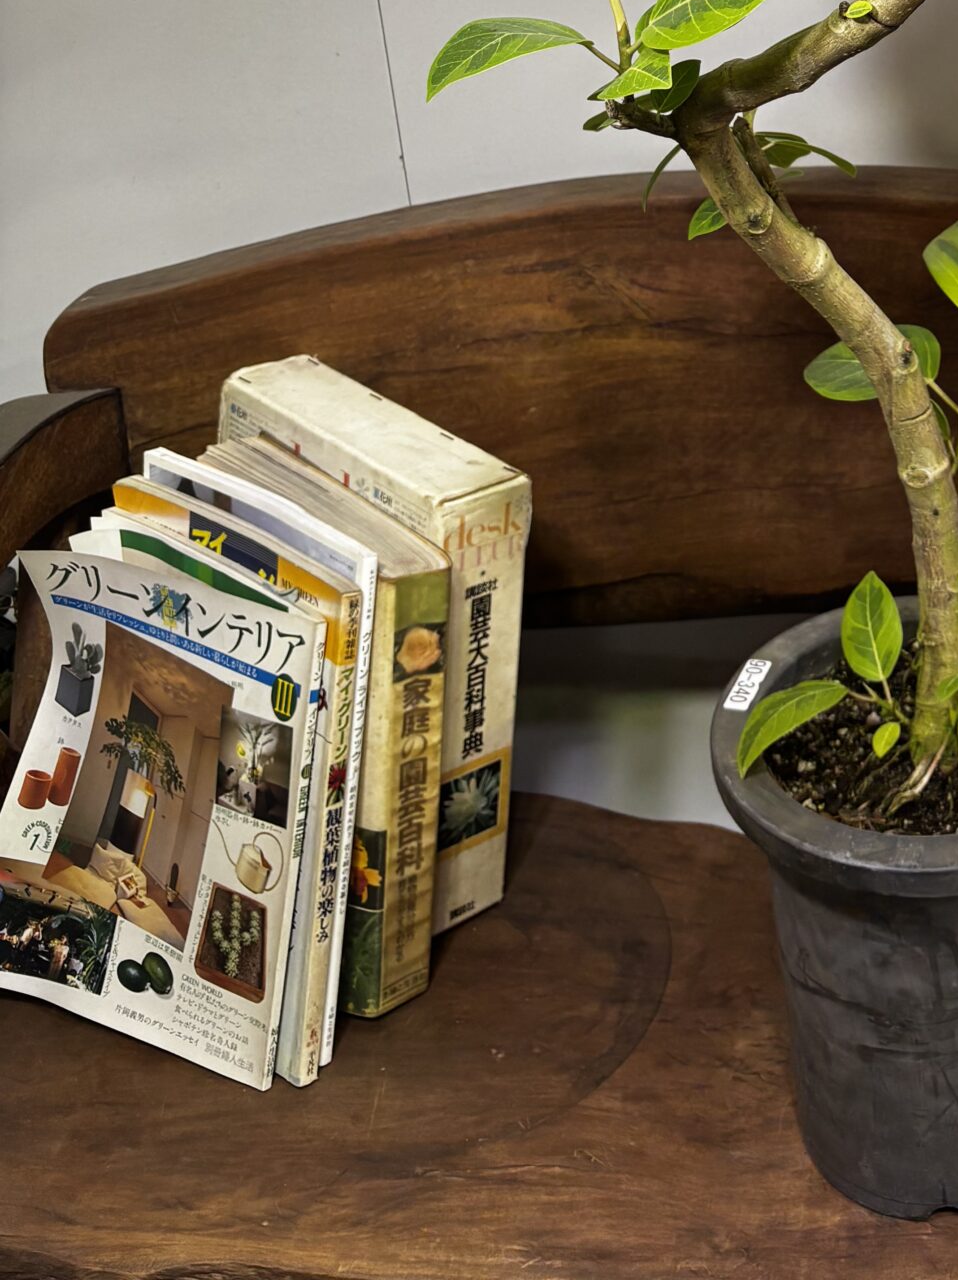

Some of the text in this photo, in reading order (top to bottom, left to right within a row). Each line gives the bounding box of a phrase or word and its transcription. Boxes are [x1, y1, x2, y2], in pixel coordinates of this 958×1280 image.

[462, 593, 492, 760] 園芸大百科事典
[729, 659, 767, 704] 90-340
[29, 833, 41, 851] 1
[396, 677, 432, 875] 家庭の園芸百科
[315, 808, 342, 943] 観葉植物の楽しみ
